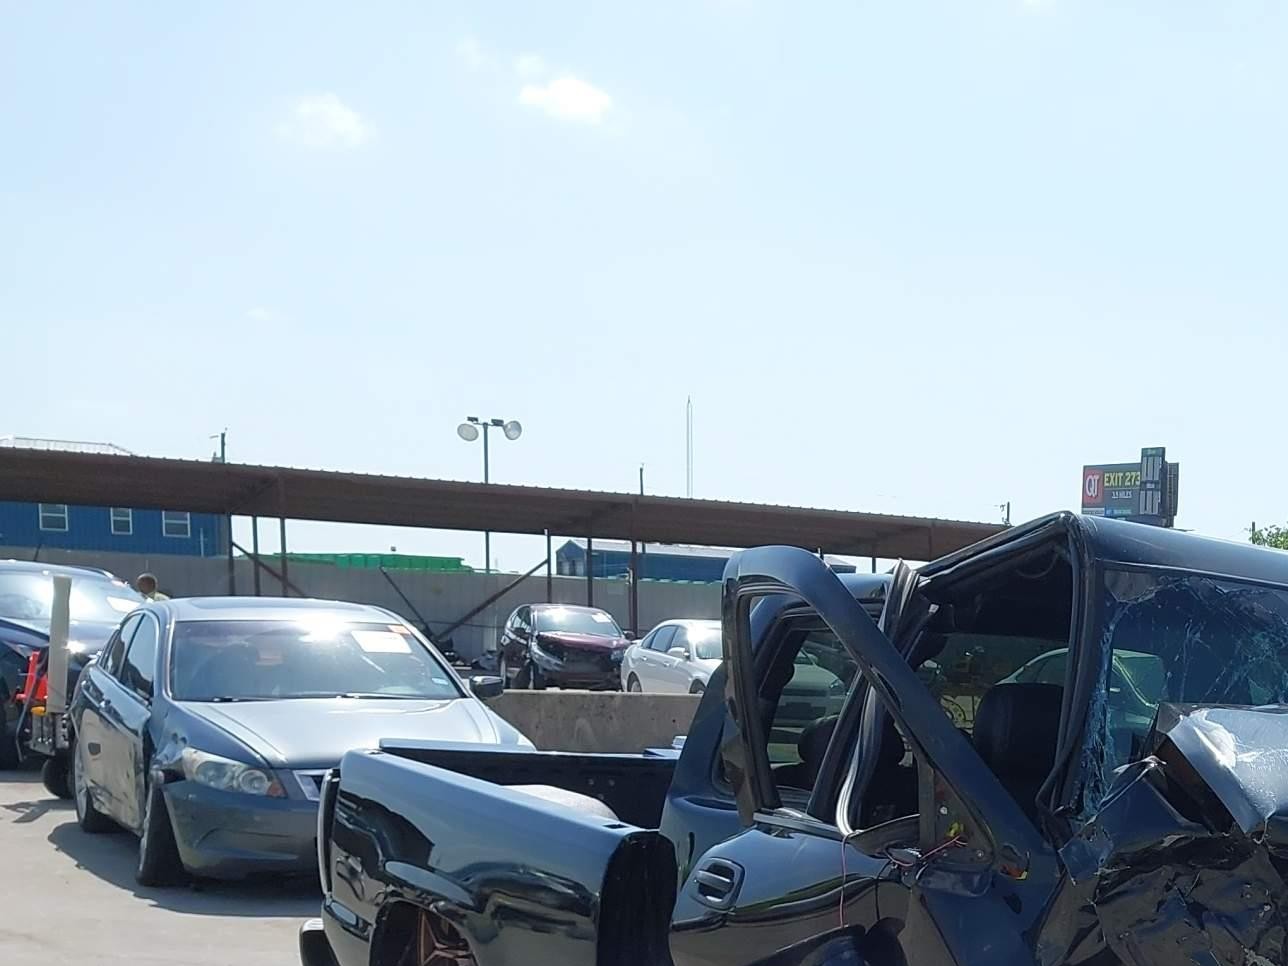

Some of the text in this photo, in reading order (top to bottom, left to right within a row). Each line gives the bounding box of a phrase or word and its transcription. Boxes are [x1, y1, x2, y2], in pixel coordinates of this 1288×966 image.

[1086, 474, 1099, 497] QT
[1104, 472, 1140, 487] EXIT 273
